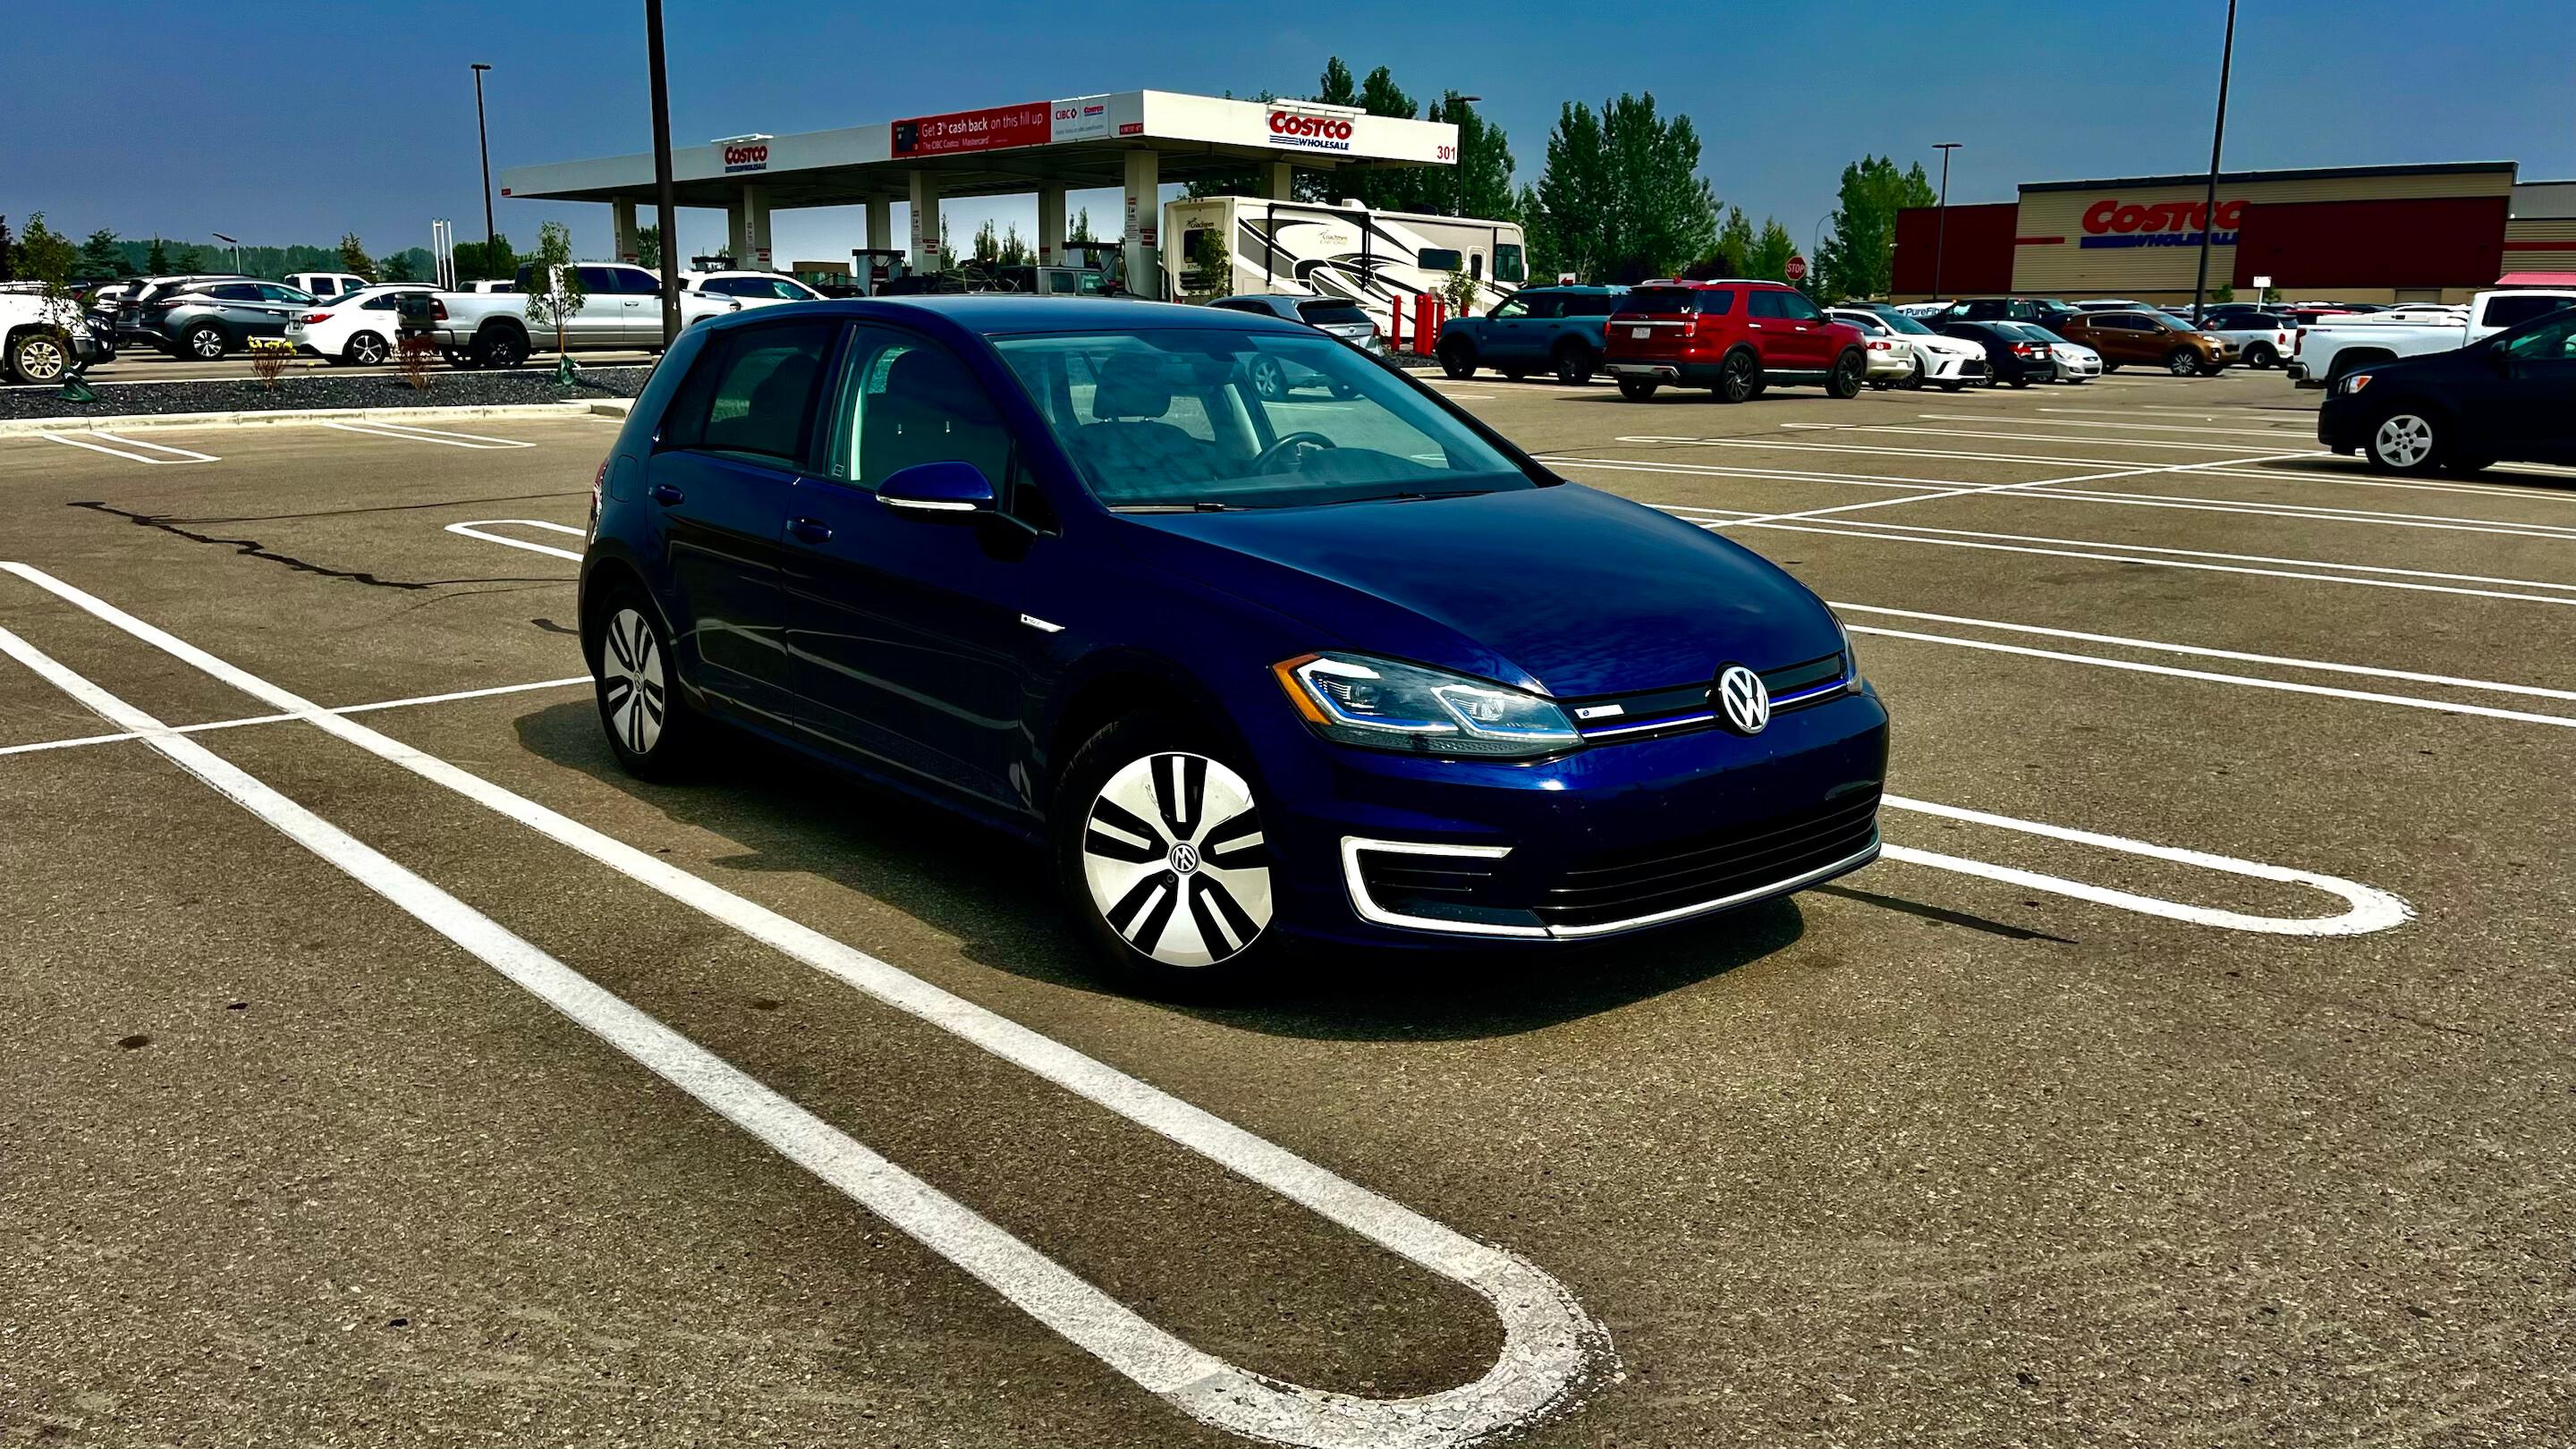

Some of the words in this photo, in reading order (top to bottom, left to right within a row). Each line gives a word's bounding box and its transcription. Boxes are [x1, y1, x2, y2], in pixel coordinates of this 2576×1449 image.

[1055, 109, 1071, 120] CIBC
[921, 123, 936, 138] Get
[948, 119, 967, 134] cash
[969, 117, 988, 132] back
[990, 118, 1001, 129] on
[1003, 114, 1018, 128] this
[1020, 112, 1030, 125] fill
[1031, 113, 1044, 126] up
[1269, 111, 1352, 140] COSTCO
[1298, 138, 1350, 150] WHOLESALE
[725, 146, 767, 165] COSTCO
[1436, 146, 1456, 161] 301
[2082, 200, 2250, 233] COSTCO
[1786, 263, 1805, 274] STOP
